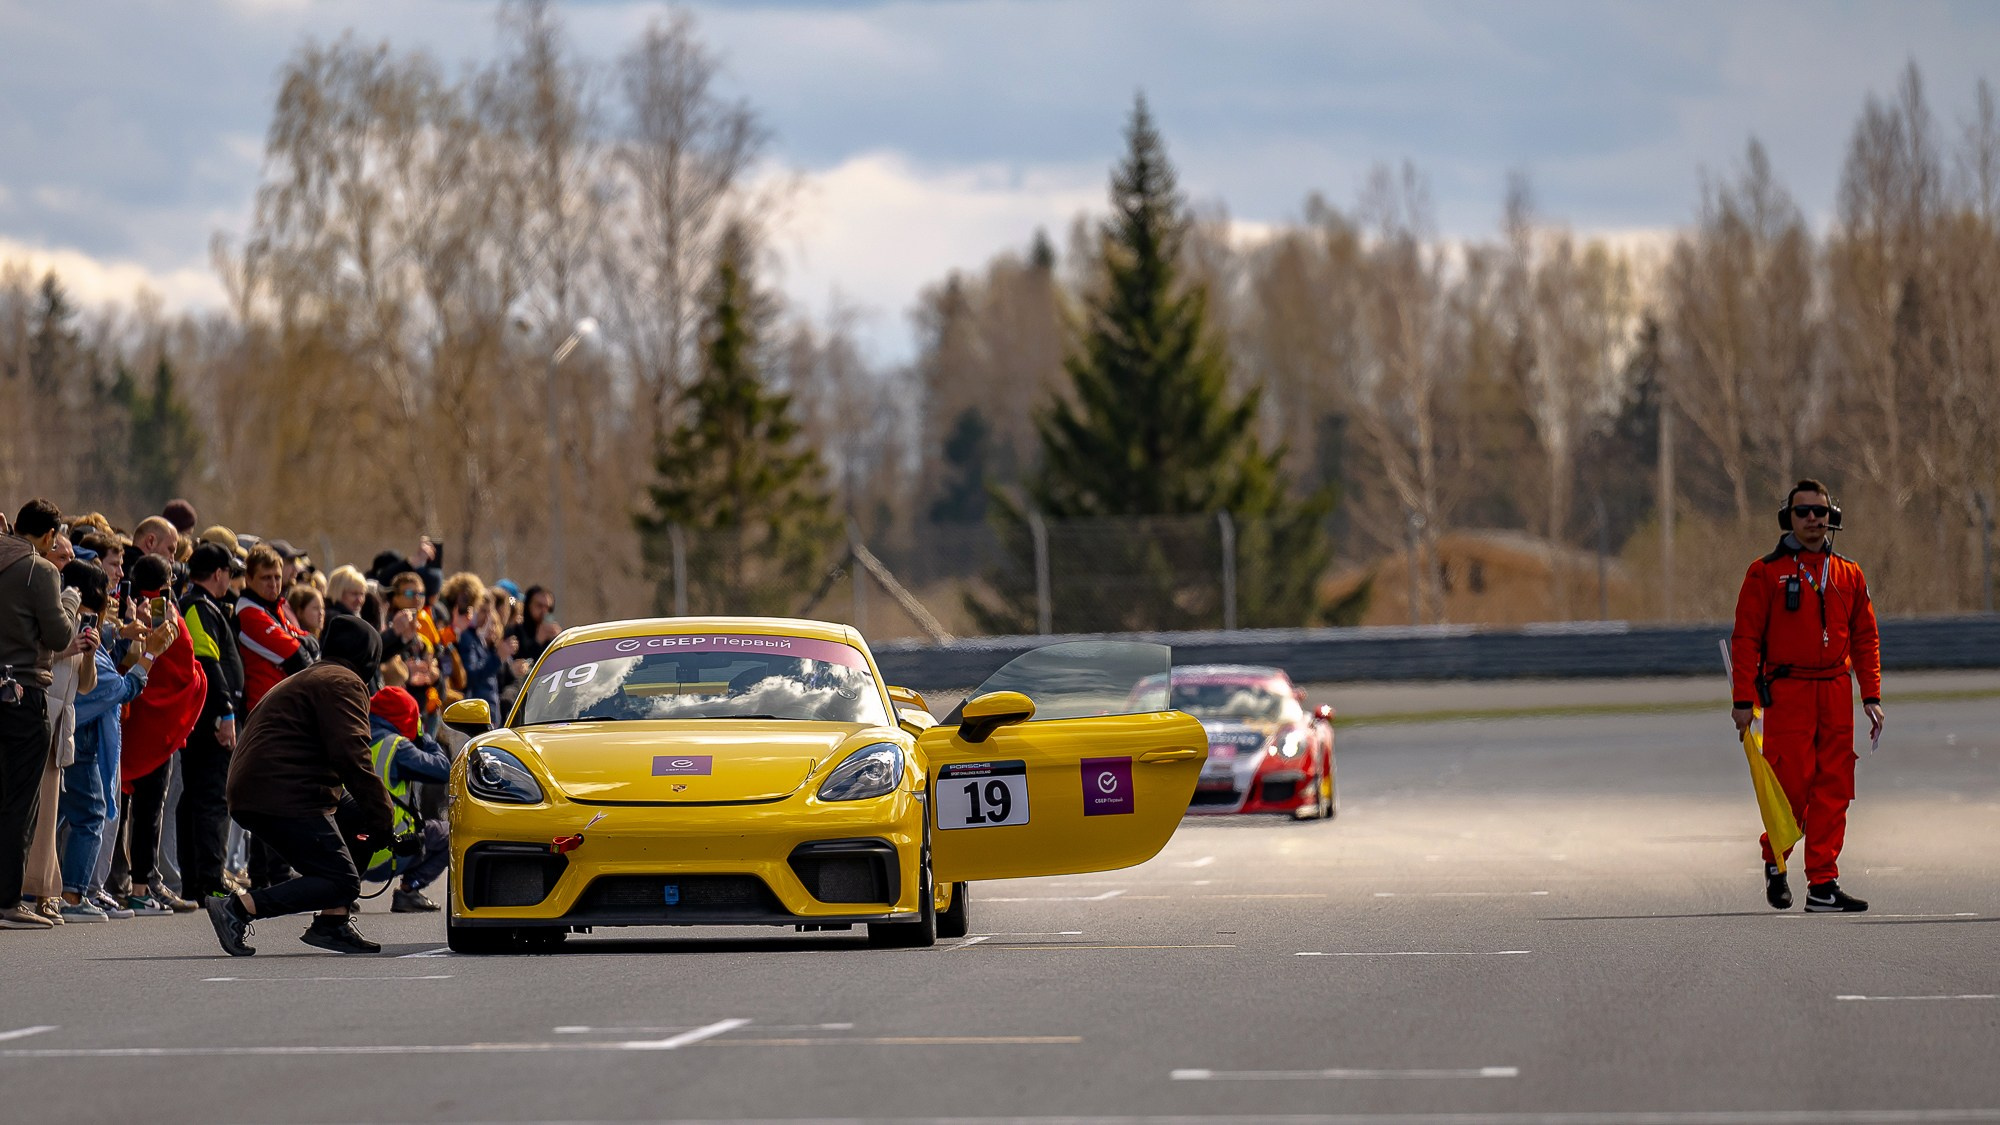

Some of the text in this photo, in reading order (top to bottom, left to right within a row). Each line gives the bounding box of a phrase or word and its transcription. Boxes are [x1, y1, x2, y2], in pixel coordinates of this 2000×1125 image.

[646, 637, 791, 649] СБЕР Первый
[542, 662, 599, 693] 19
[964, 780, 1011, 824] 19
